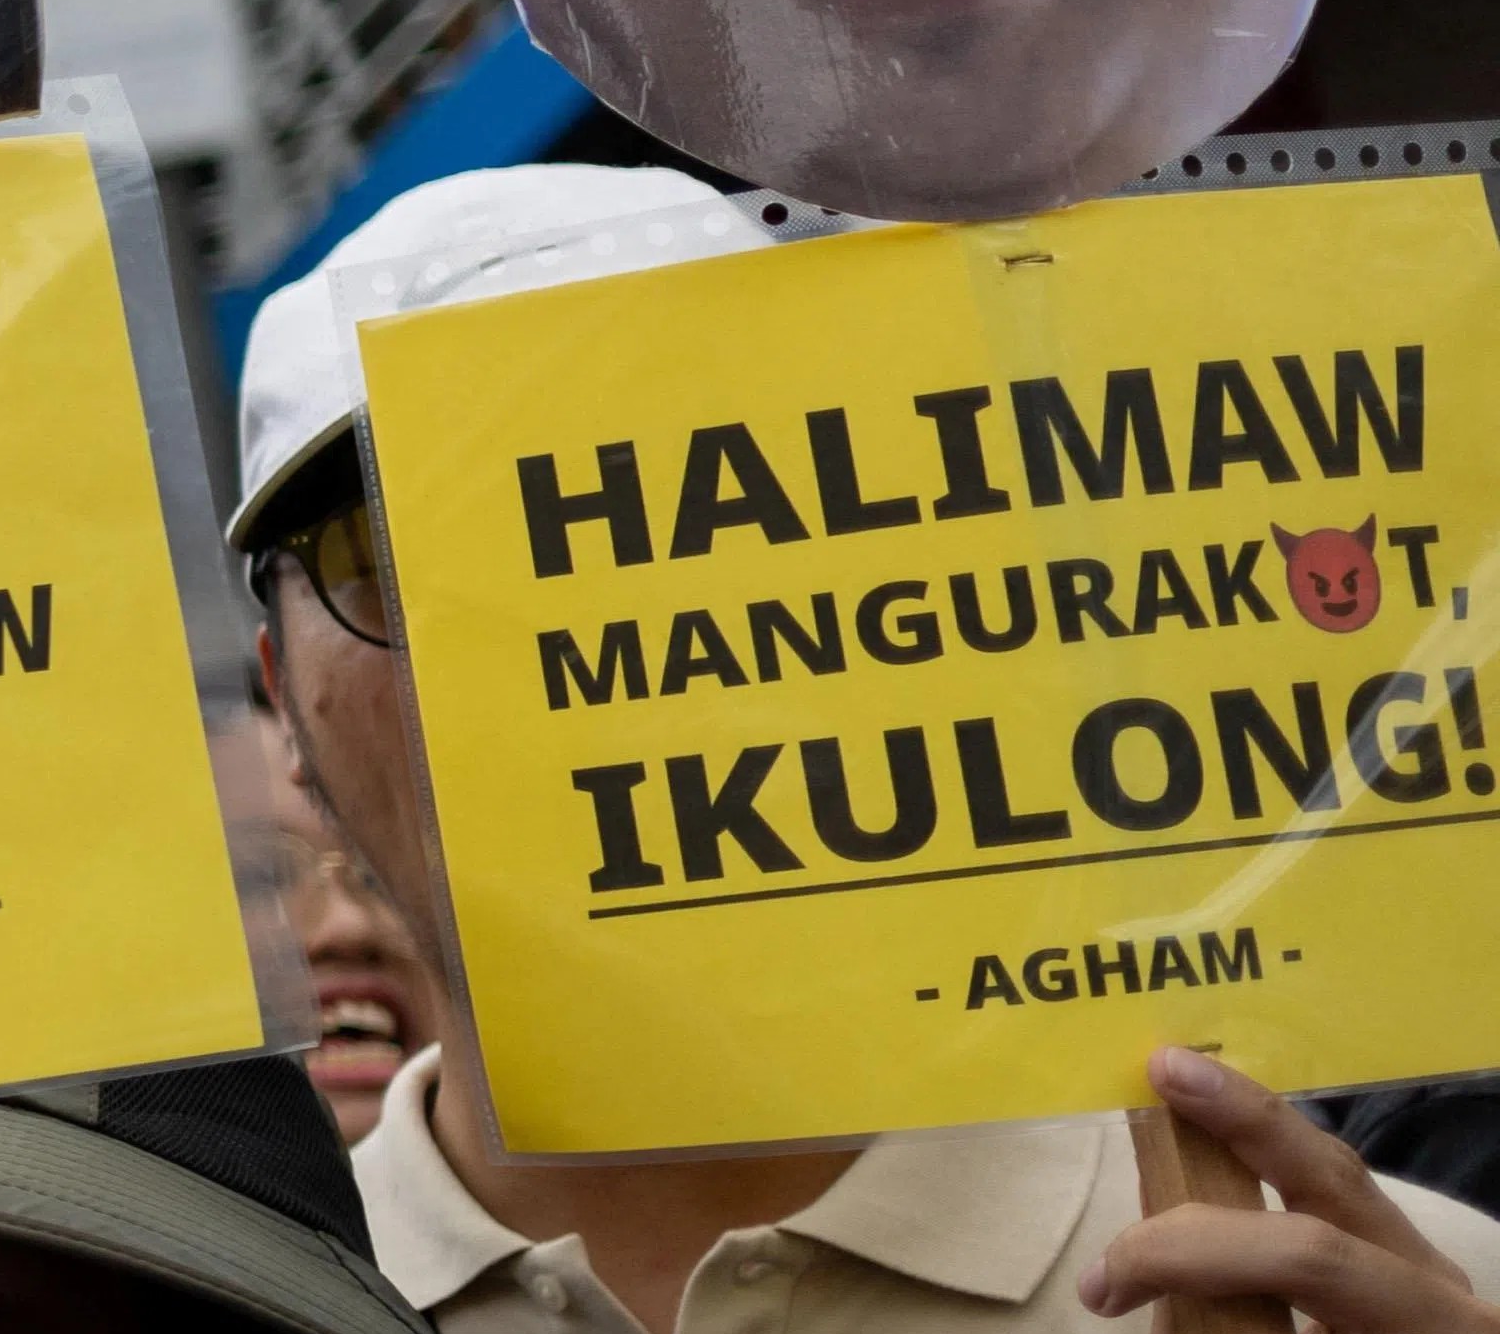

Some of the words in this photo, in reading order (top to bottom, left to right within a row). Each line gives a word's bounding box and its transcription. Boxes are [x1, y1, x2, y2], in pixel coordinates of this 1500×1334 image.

[515, 344, 1426, 580] HALIMAW
[571, 666, 1497, 894] IKULONG!
[964, 927, 1264, 1011] AGHAM
